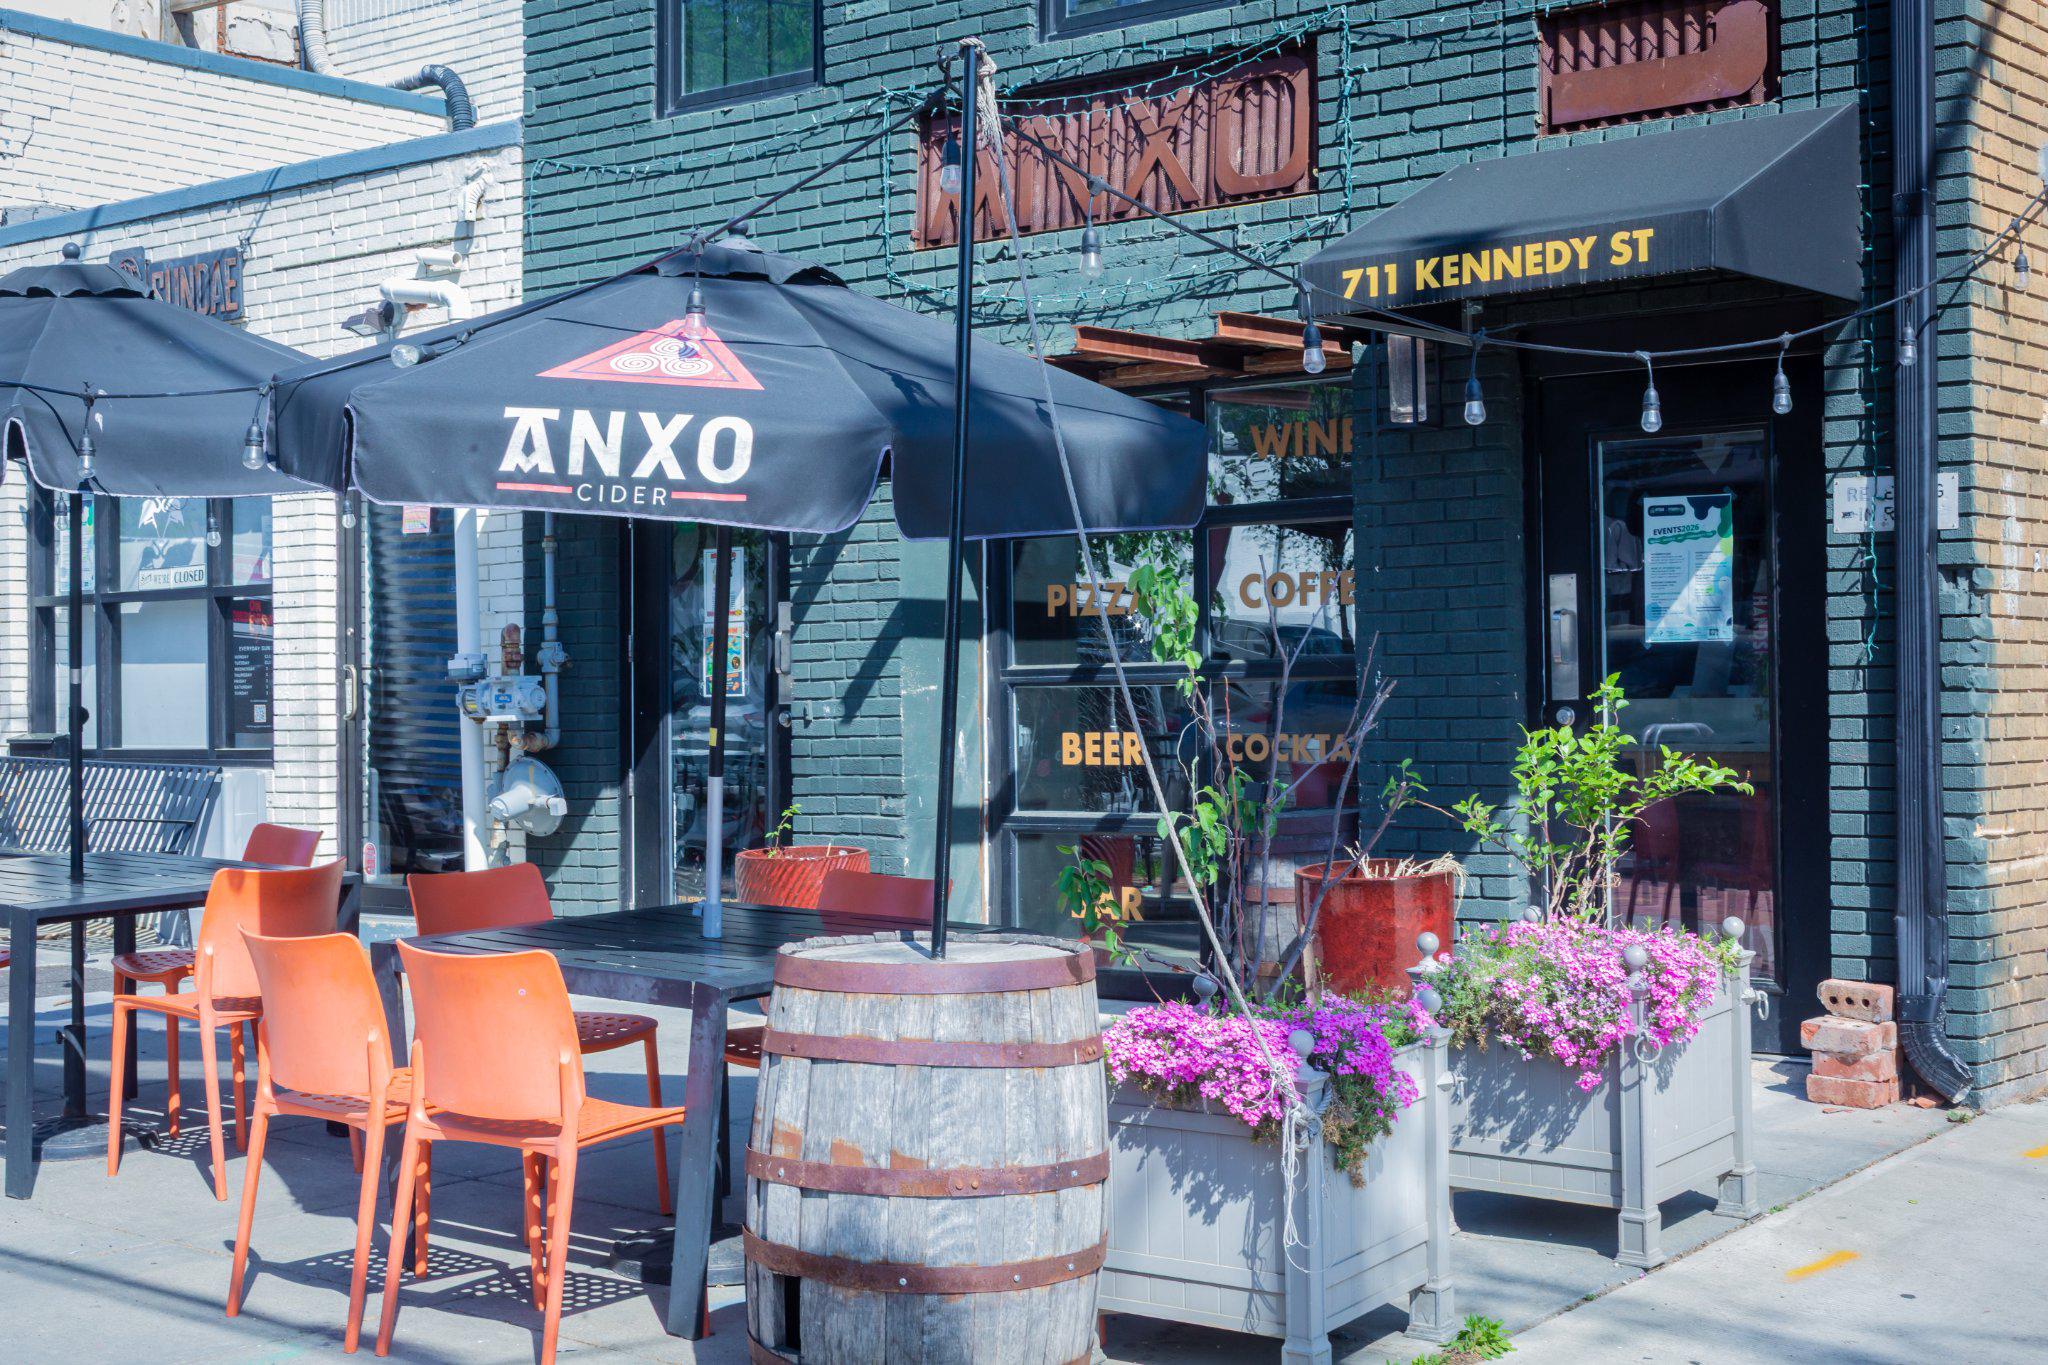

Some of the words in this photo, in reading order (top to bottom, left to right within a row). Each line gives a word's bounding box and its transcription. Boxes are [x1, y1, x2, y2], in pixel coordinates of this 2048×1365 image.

[927, 55, 1310, 241] ANXO
[1342, 264, 1397, 299] 711
[1416, 235, 1598, 291] KENNEDY
[1610, 228, 1654, 266] ST
[498, 406, 754, 484] ANXO
[577, 483, 668, 506] CIDER
[173, 569, 204, 584] CLOSED
[1061, 731, 1147, 766] BEER
